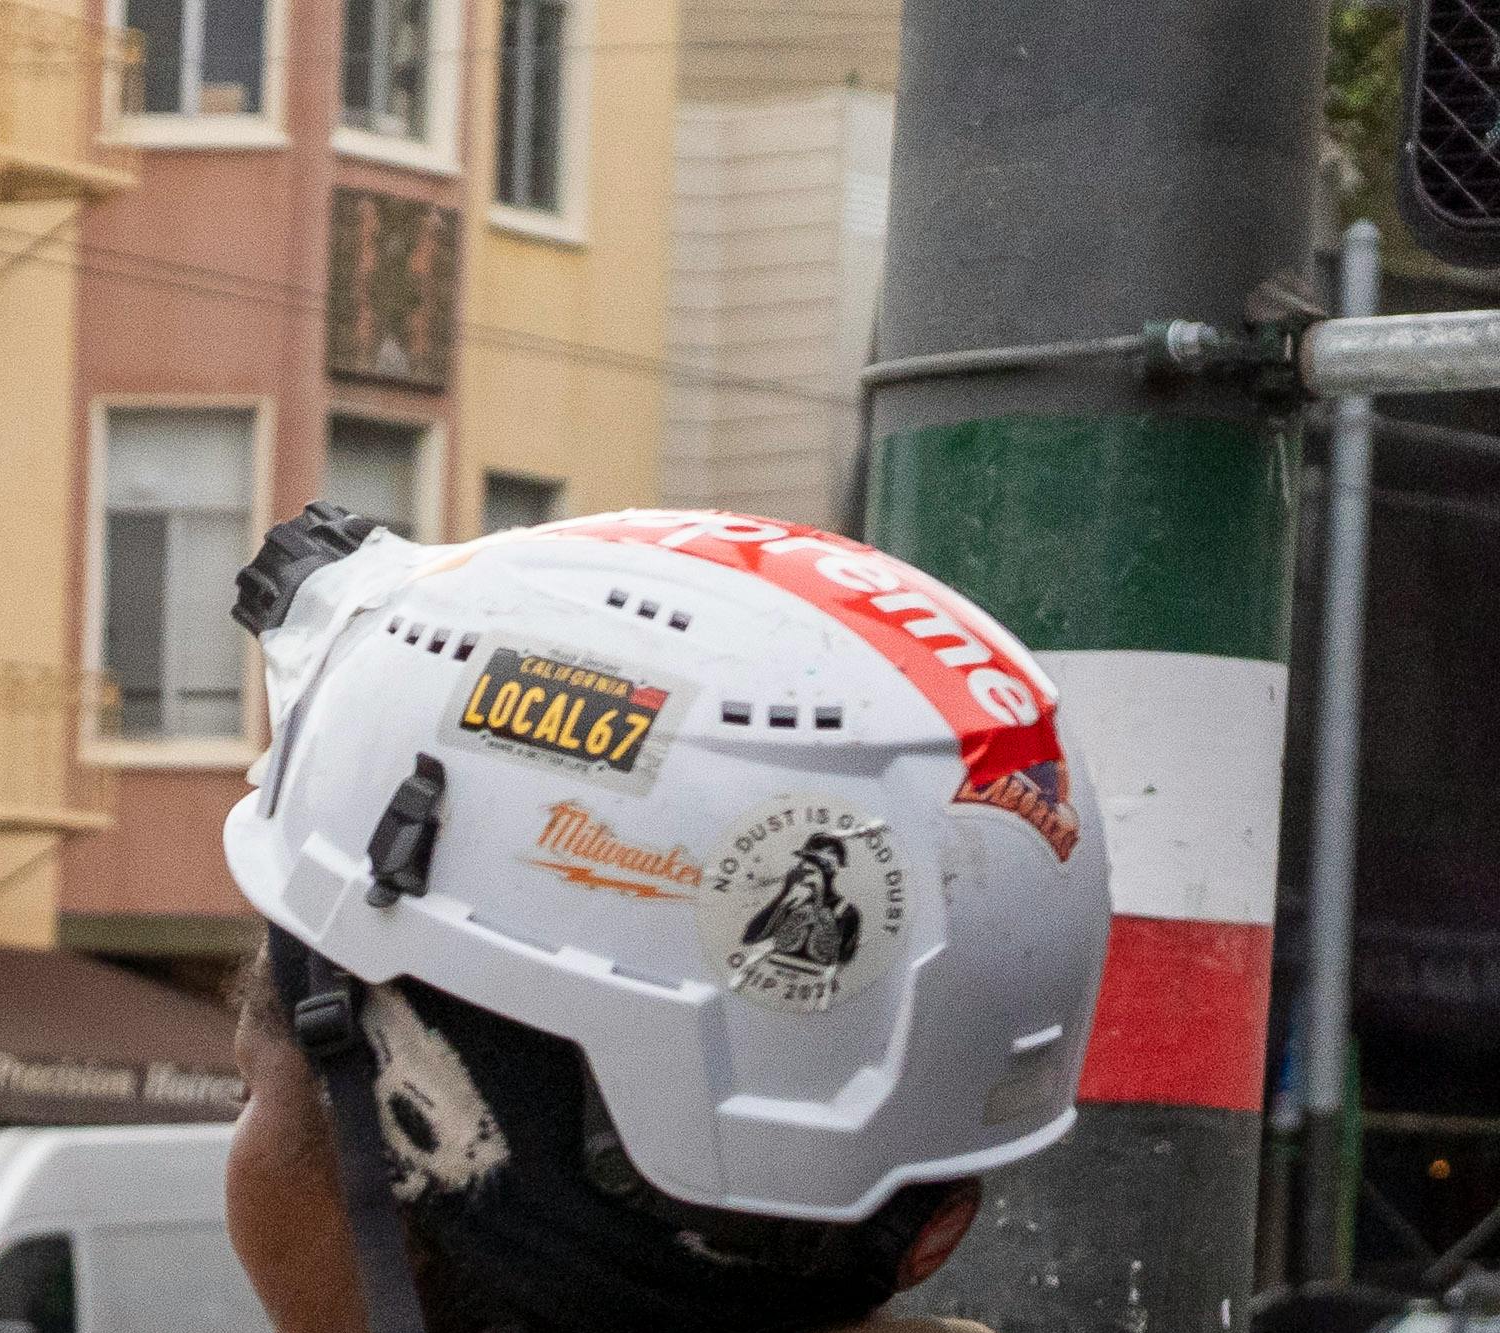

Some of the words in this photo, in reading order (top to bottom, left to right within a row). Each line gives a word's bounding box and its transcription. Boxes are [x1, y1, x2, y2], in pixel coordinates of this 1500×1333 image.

[618, 509, 1042, 728] preme
[463, 672, 586, 750] LOCAL
[584, 707, 650, 761] 67
[520, 656, 629, 699] CALIFORNIA
[713, 856, 740, 894] NO
[734, 808, 796, 854] DUST
[806, 806, 831, 825] IS
[837, 813, 893, 864] GOD
[883, 869, 905, 935] DUST
